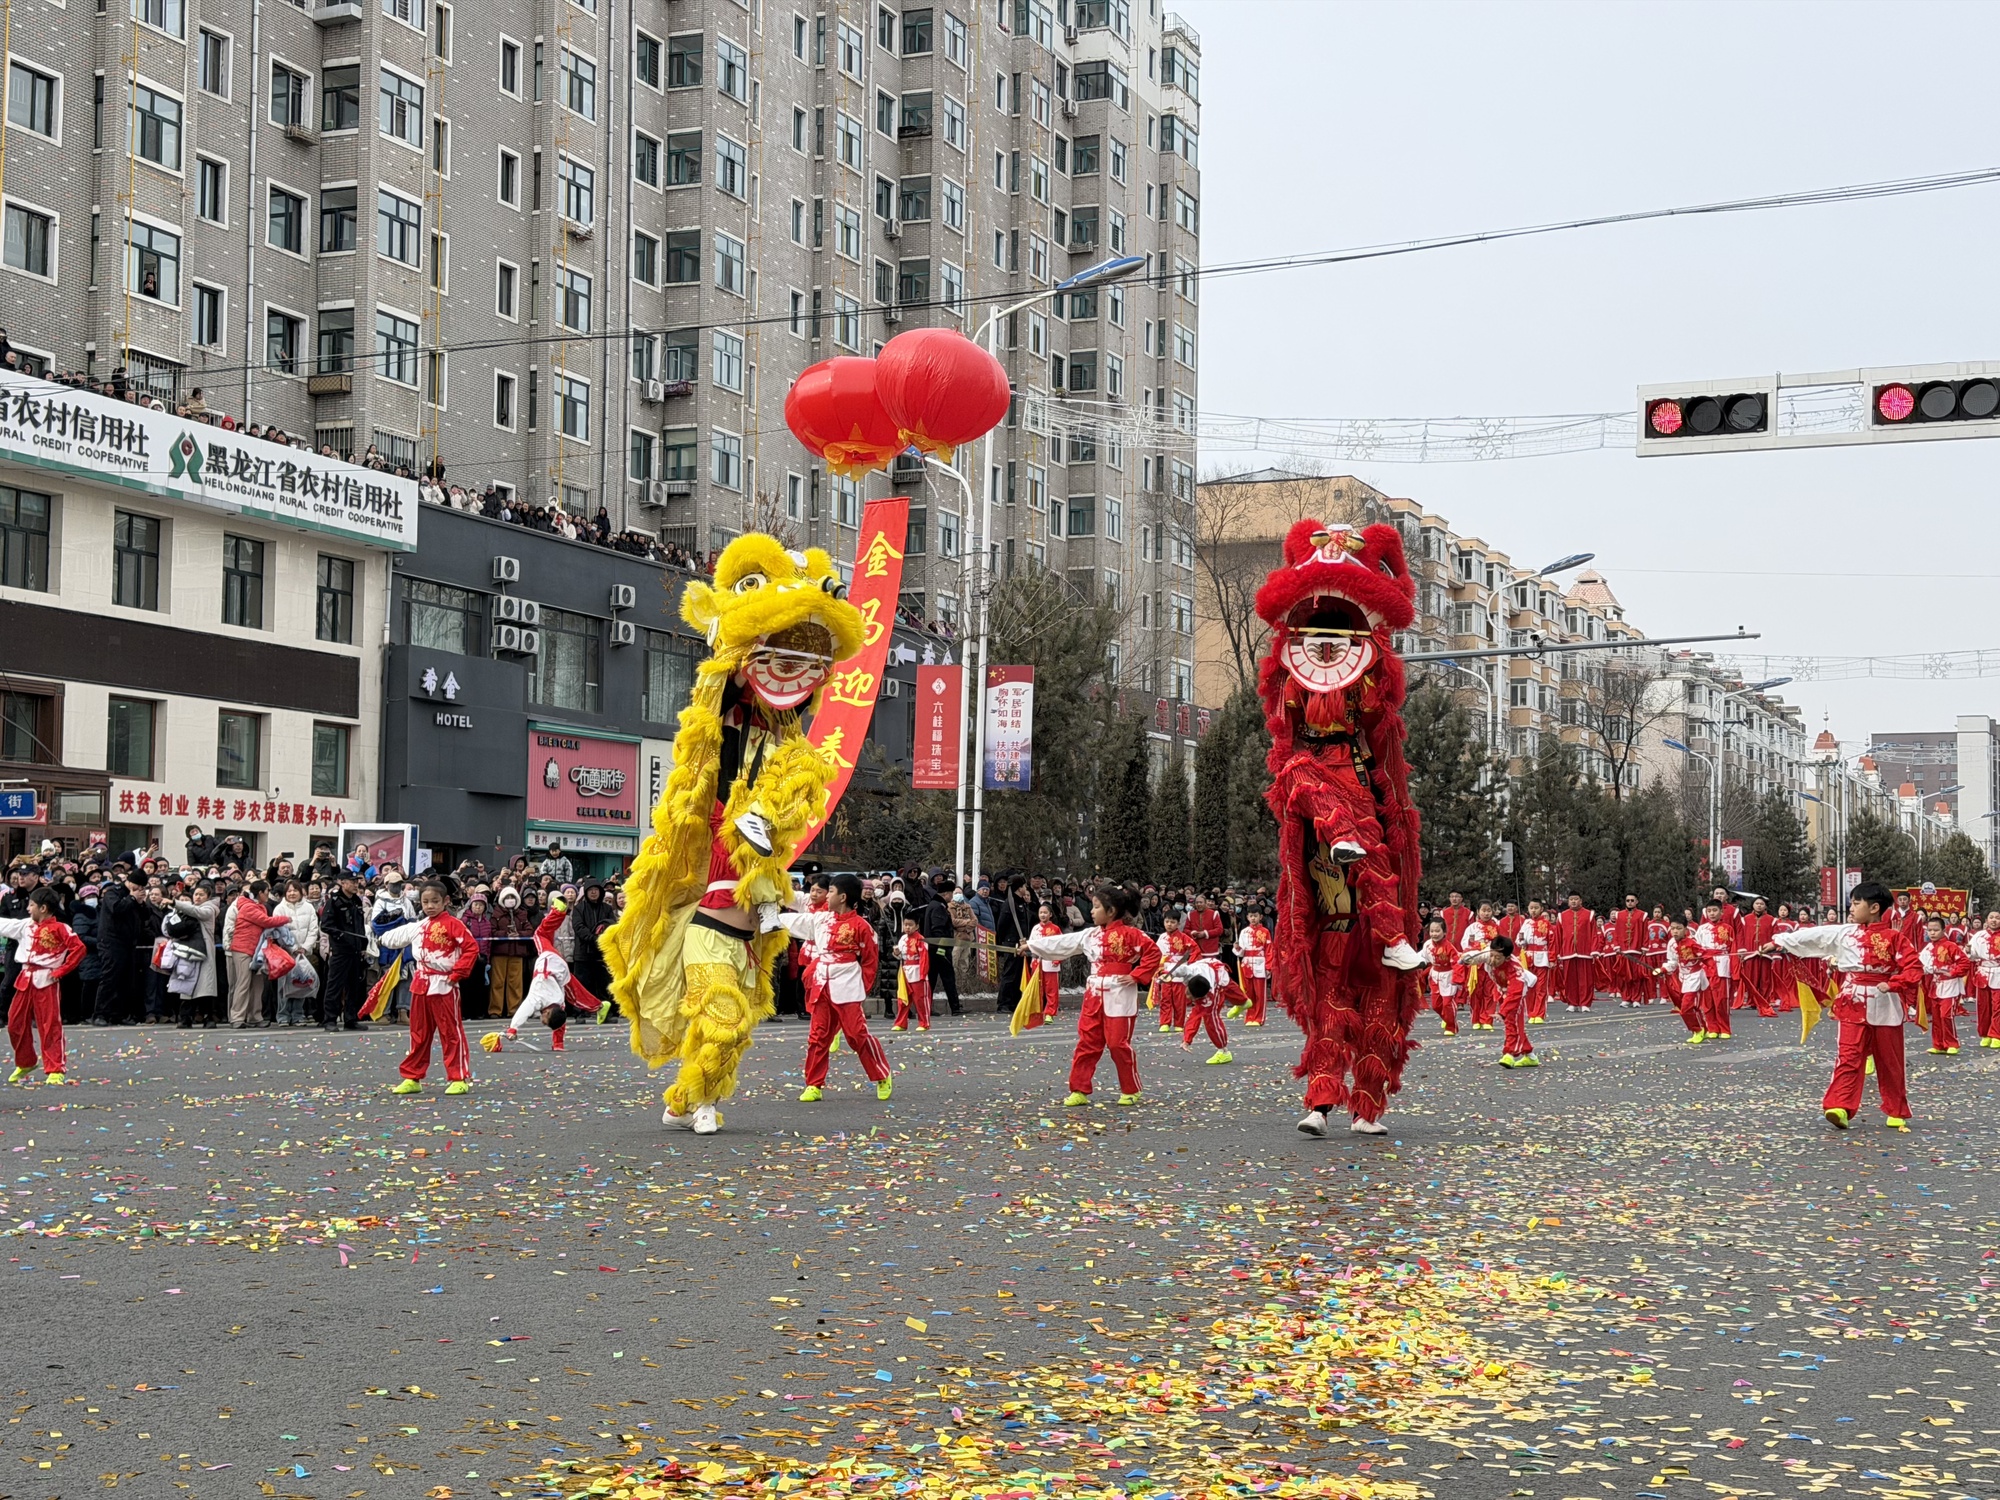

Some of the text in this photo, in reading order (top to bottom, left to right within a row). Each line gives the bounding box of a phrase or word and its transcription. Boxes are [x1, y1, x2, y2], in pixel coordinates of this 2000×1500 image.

[32, 434, 73, 454] CREDIT
[77, 445, 149, 472] COOPERATIVE
[204, 476, 404, 534] HEILONGJIANG RURAL CREDIT COOPERATIVE
[205, 442, 404, 521] 黑龙江省农村信用社
[806, 531, 903, 829] 金马迎春
[436, 712, 473, 728] HOTEL
[931, 701, 944, 772] 六桂福珠宝
[570, 766, 626, 797] 布蕾斯特
[119, 790, 347, 828] 扶贫 创业 养老 涉农贷款服务中心
